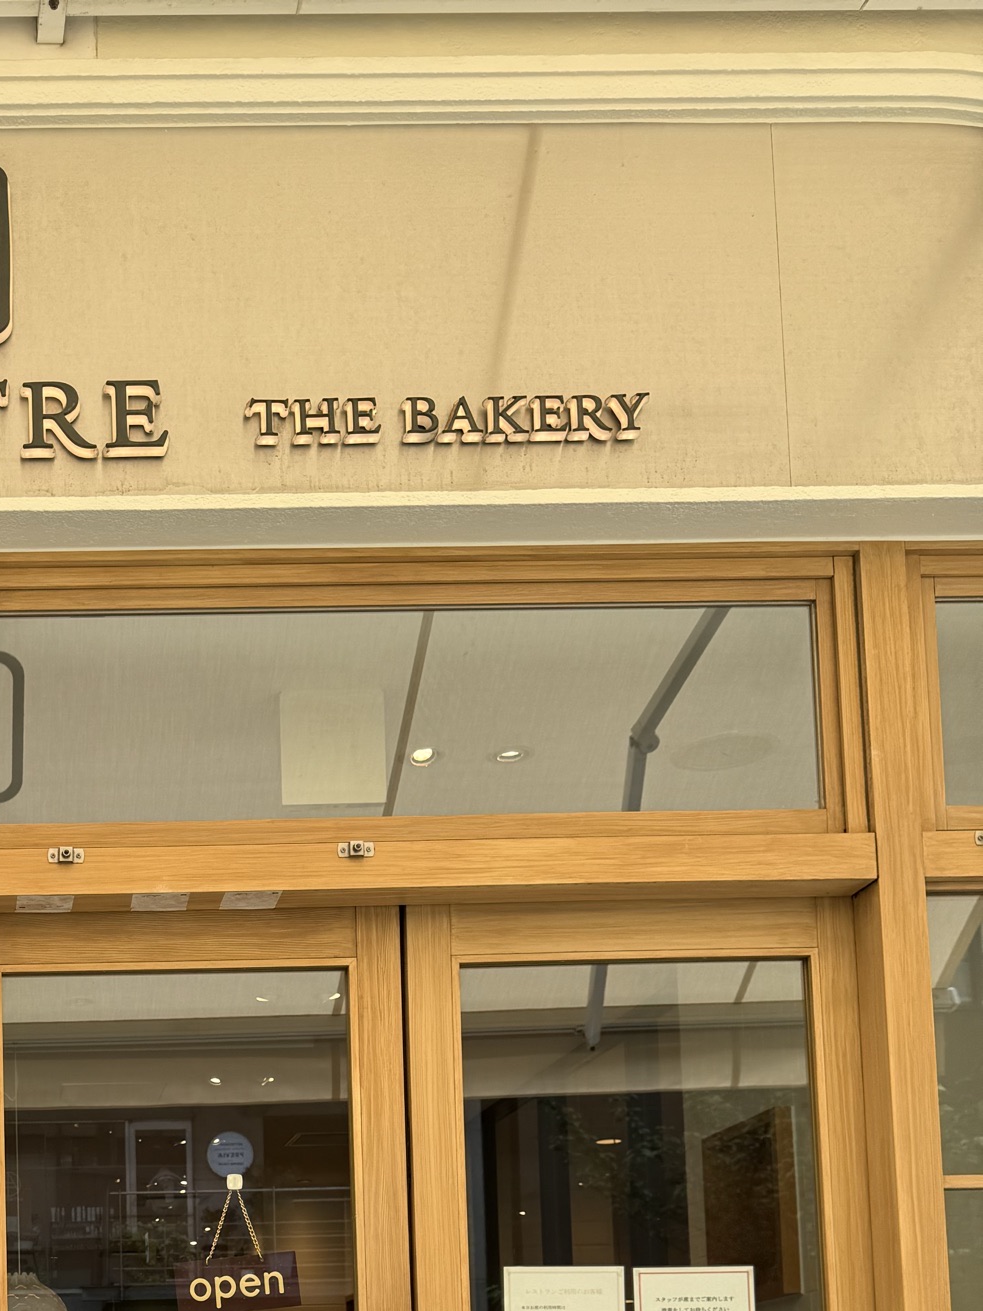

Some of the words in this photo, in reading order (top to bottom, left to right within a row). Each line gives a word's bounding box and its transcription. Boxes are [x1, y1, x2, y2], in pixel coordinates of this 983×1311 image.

[245, 396, 382, 446] THE
[402, 391, 651, 444] BAKERY
[189, 1270, 285, 1309] open
